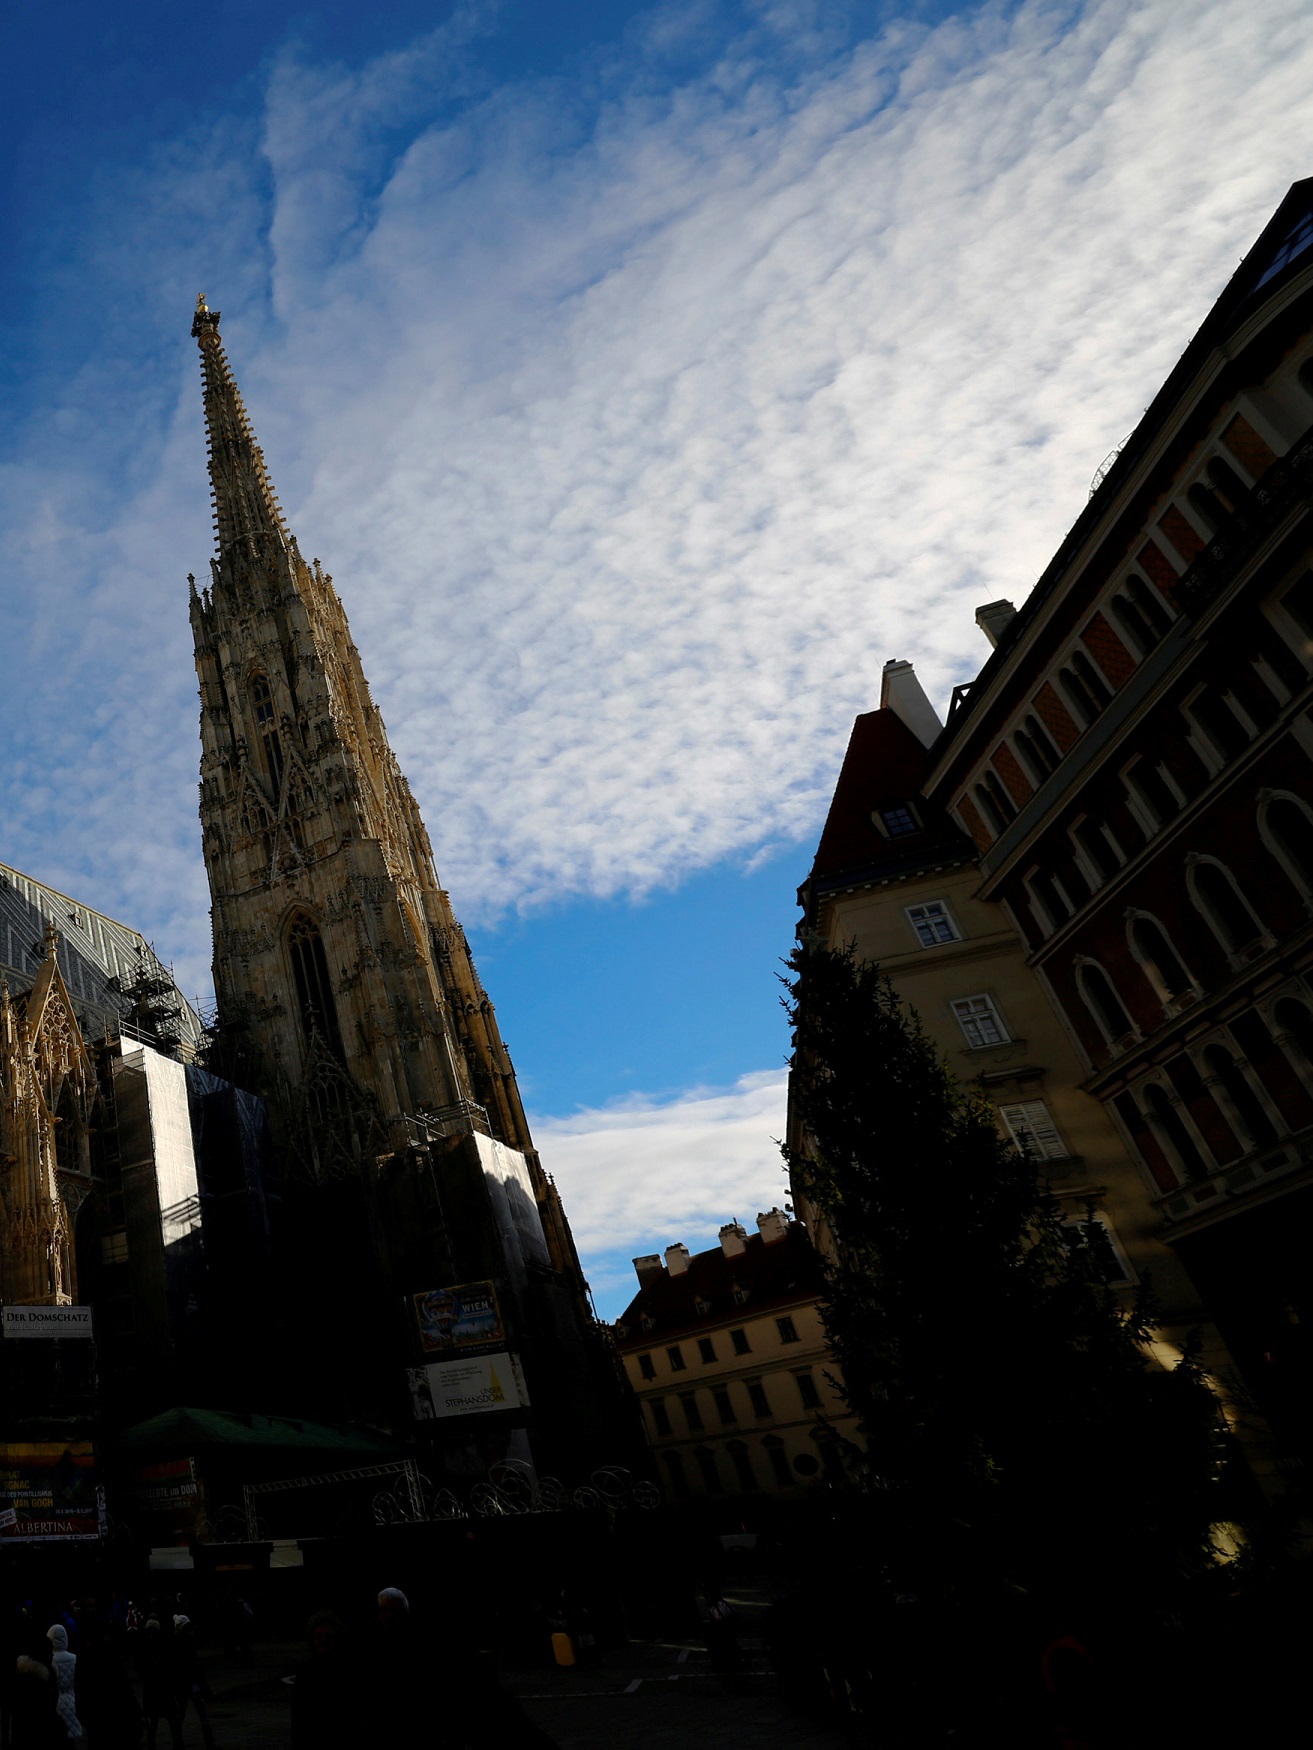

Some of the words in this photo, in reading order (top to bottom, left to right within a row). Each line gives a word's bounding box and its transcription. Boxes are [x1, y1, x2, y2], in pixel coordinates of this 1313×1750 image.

[461, 1301, 489, 1313] WIEN
[7, 1313, 26, 1321] DER
[28, 1312, 88, 1321] DOMSCHATZ
[480, 1386, 502, 1395] UNSER
[445, 1393, 505, 1407] STEPHANSDOM
[13, 1499, 29, 1509] VAN
[31, 1498, 54, 1508] GOGH
[13, 1521, 74, 1534] ALBERTINA
